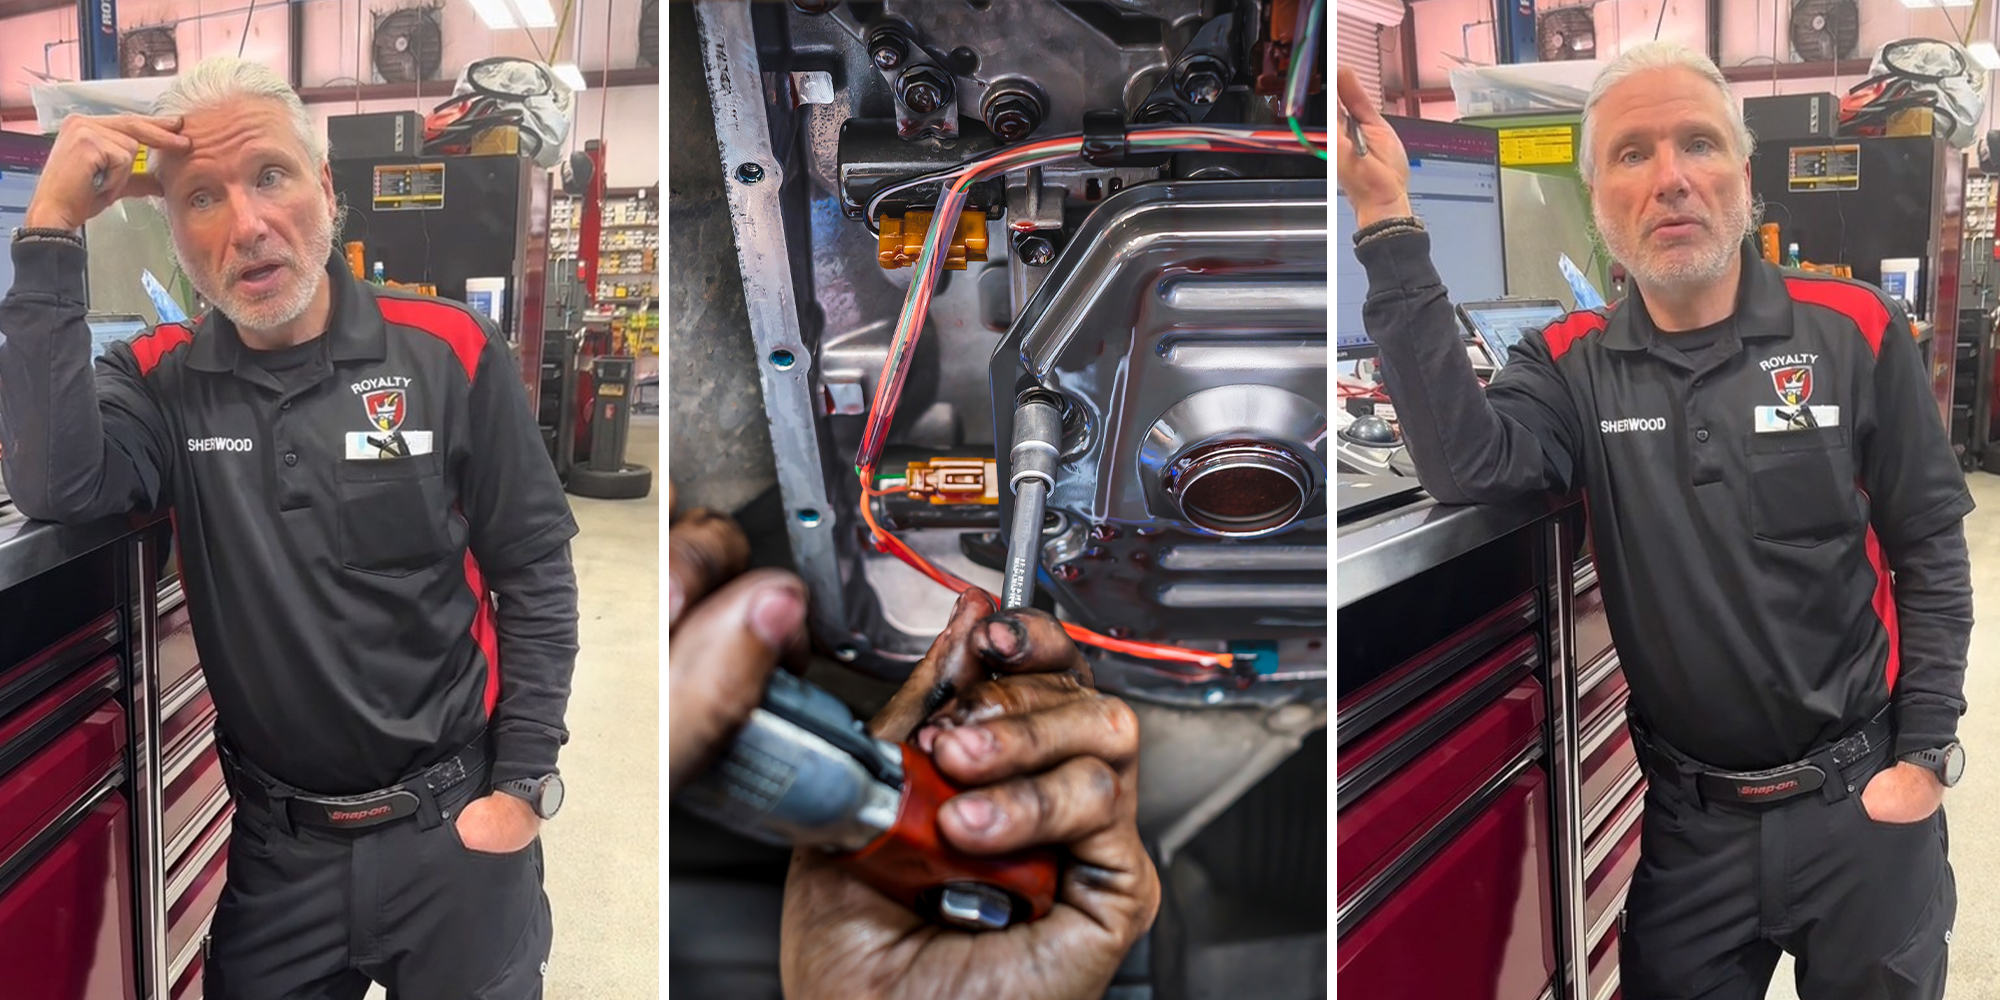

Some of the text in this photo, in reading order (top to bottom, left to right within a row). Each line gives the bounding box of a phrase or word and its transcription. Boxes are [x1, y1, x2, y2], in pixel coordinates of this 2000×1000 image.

[1759, 353, 1819, 371] ROYALTY
[350, 376, 412, 395] ROYALTY
[1600, 417, 1667, 433] SHERWOOD
[187, 437, 253, 452] SHERWOOD
[1740, 780, 1797, 796] Snap-on
[331, 805, 389, 821] Snap-on
